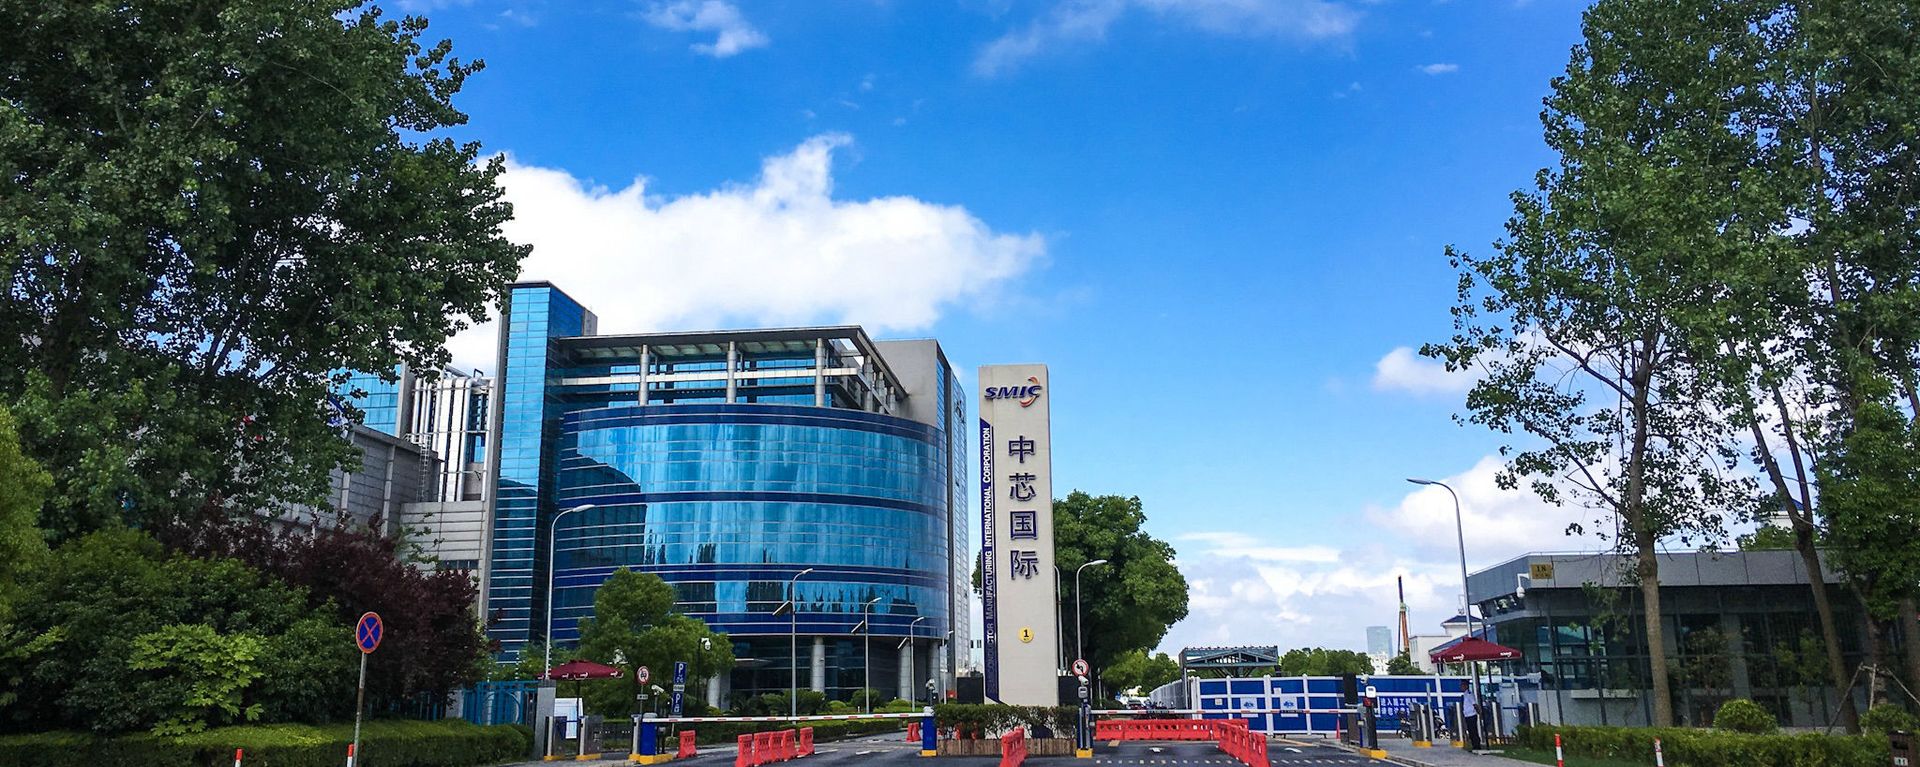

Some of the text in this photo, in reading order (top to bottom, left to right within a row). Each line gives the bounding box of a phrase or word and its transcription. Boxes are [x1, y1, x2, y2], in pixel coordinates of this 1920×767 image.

[985, 385, 1042, 399] SMIC
[983, 427, 991, 483] CORPORATION
[984, 486, 993, 547] INTERNATIONAL
[1008, 435, 1039, 580] 中芯国际
[985, 550, 994, 619] MANUFACTURING
[1024, 629, 1029, 638] 1
[679, 663, 684, 674] P
[676, 693, 681, 704] P
